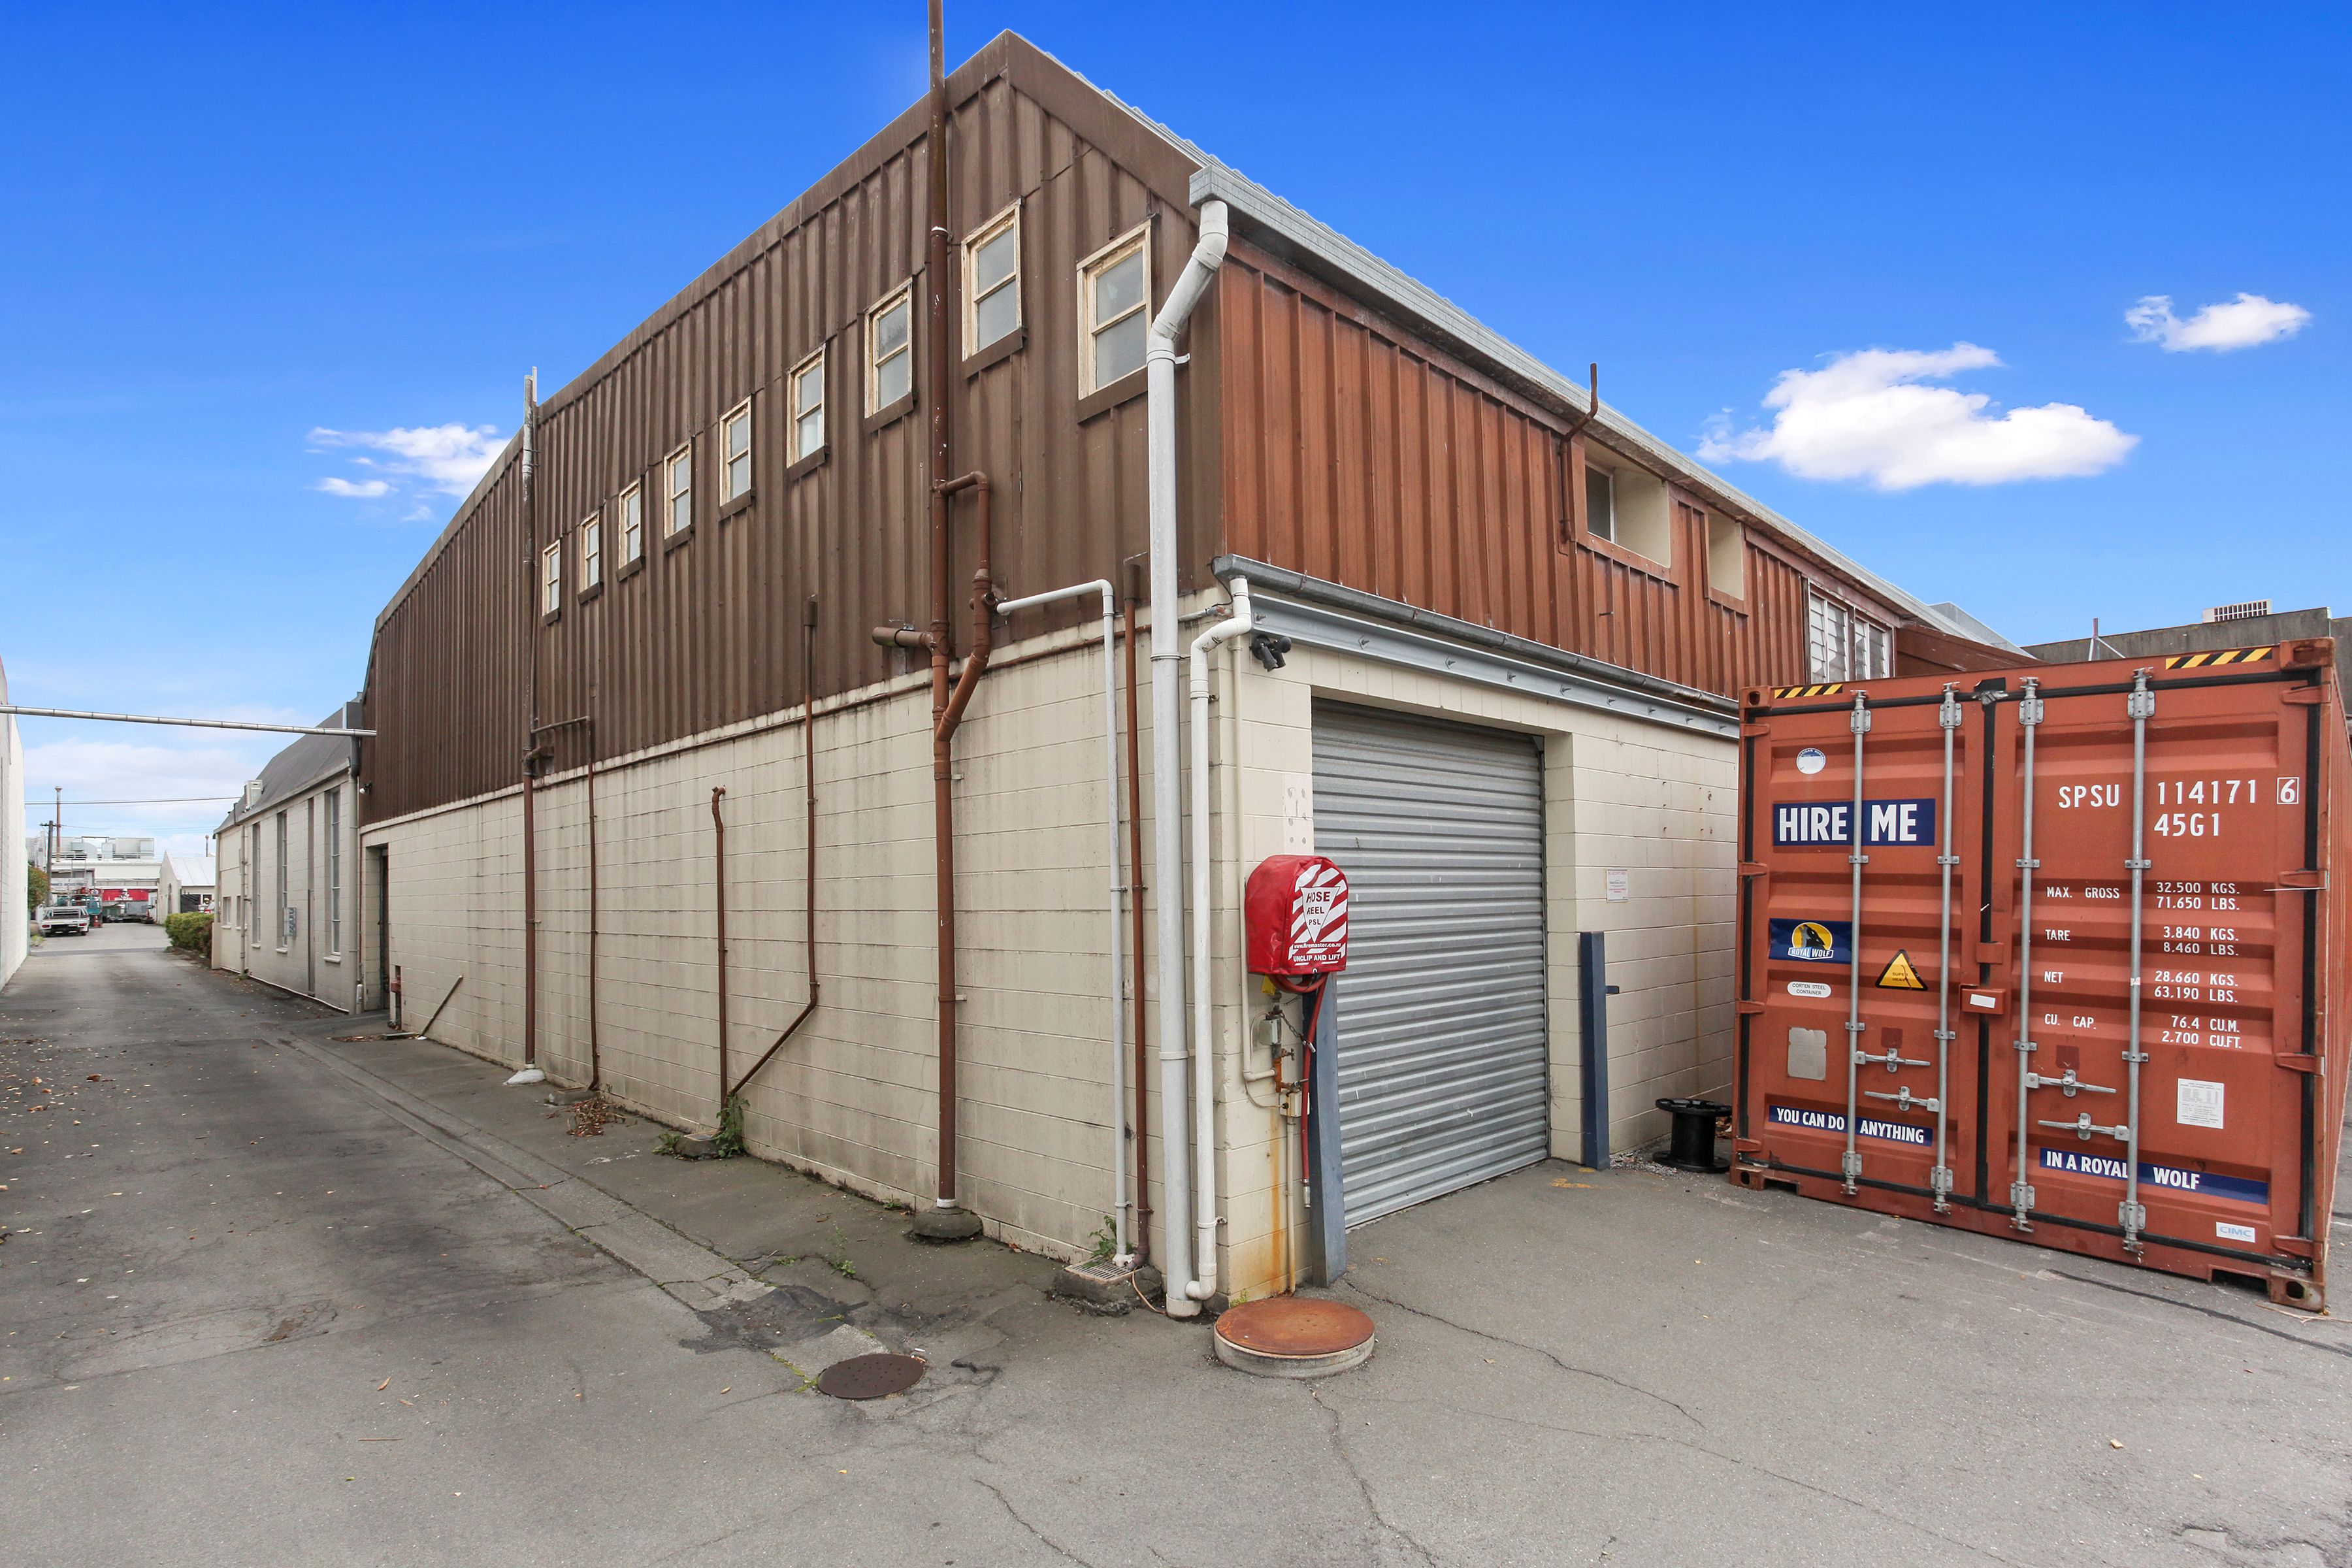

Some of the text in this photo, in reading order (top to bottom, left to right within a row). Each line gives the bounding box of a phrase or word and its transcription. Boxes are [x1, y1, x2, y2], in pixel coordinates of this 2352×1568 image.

[2058, 779, 2296, 808] SPSU 114171 6
[1779, 803, 1917, 841] HIRE ME
[2153, 813, 2219, 837] 45G1
[1306, 891, 1331, 904] HOSE
[2046, 886, 2072, 898] MAX.
[2085, 887, 2120, 899] GROSS
[2211, 883, 2240, 894] KGS.
[1307, 906, 1325, 915] REEL
[2211, 897, 2240, 911] LBS.
[2045, 929, 2070, 941] TARE
[2210, 928, 2239, 941] KGS.
[1791, 948, 1831, 958] ROYAL WOLF
[2210, 943, 2239, 956] LBS.
[2044, 971, 2063, 983] NET
[2209, 973, 2238, 987] KGS.
[2209, 988, 2238, 1003] LBS.
[2044, 1013, 2240, 1033] CU. CAP. 76.4 CU.M.
[2209, 1034, 2242, 1049] CU.FT.
[1776, 1107, 1924, 1143] YOU CAN DO ANYTHING
[2046, 1151, 2200, 1190] IN A ROYAL WOLF
[2219, 1226, 2251, 1237] CIMC
